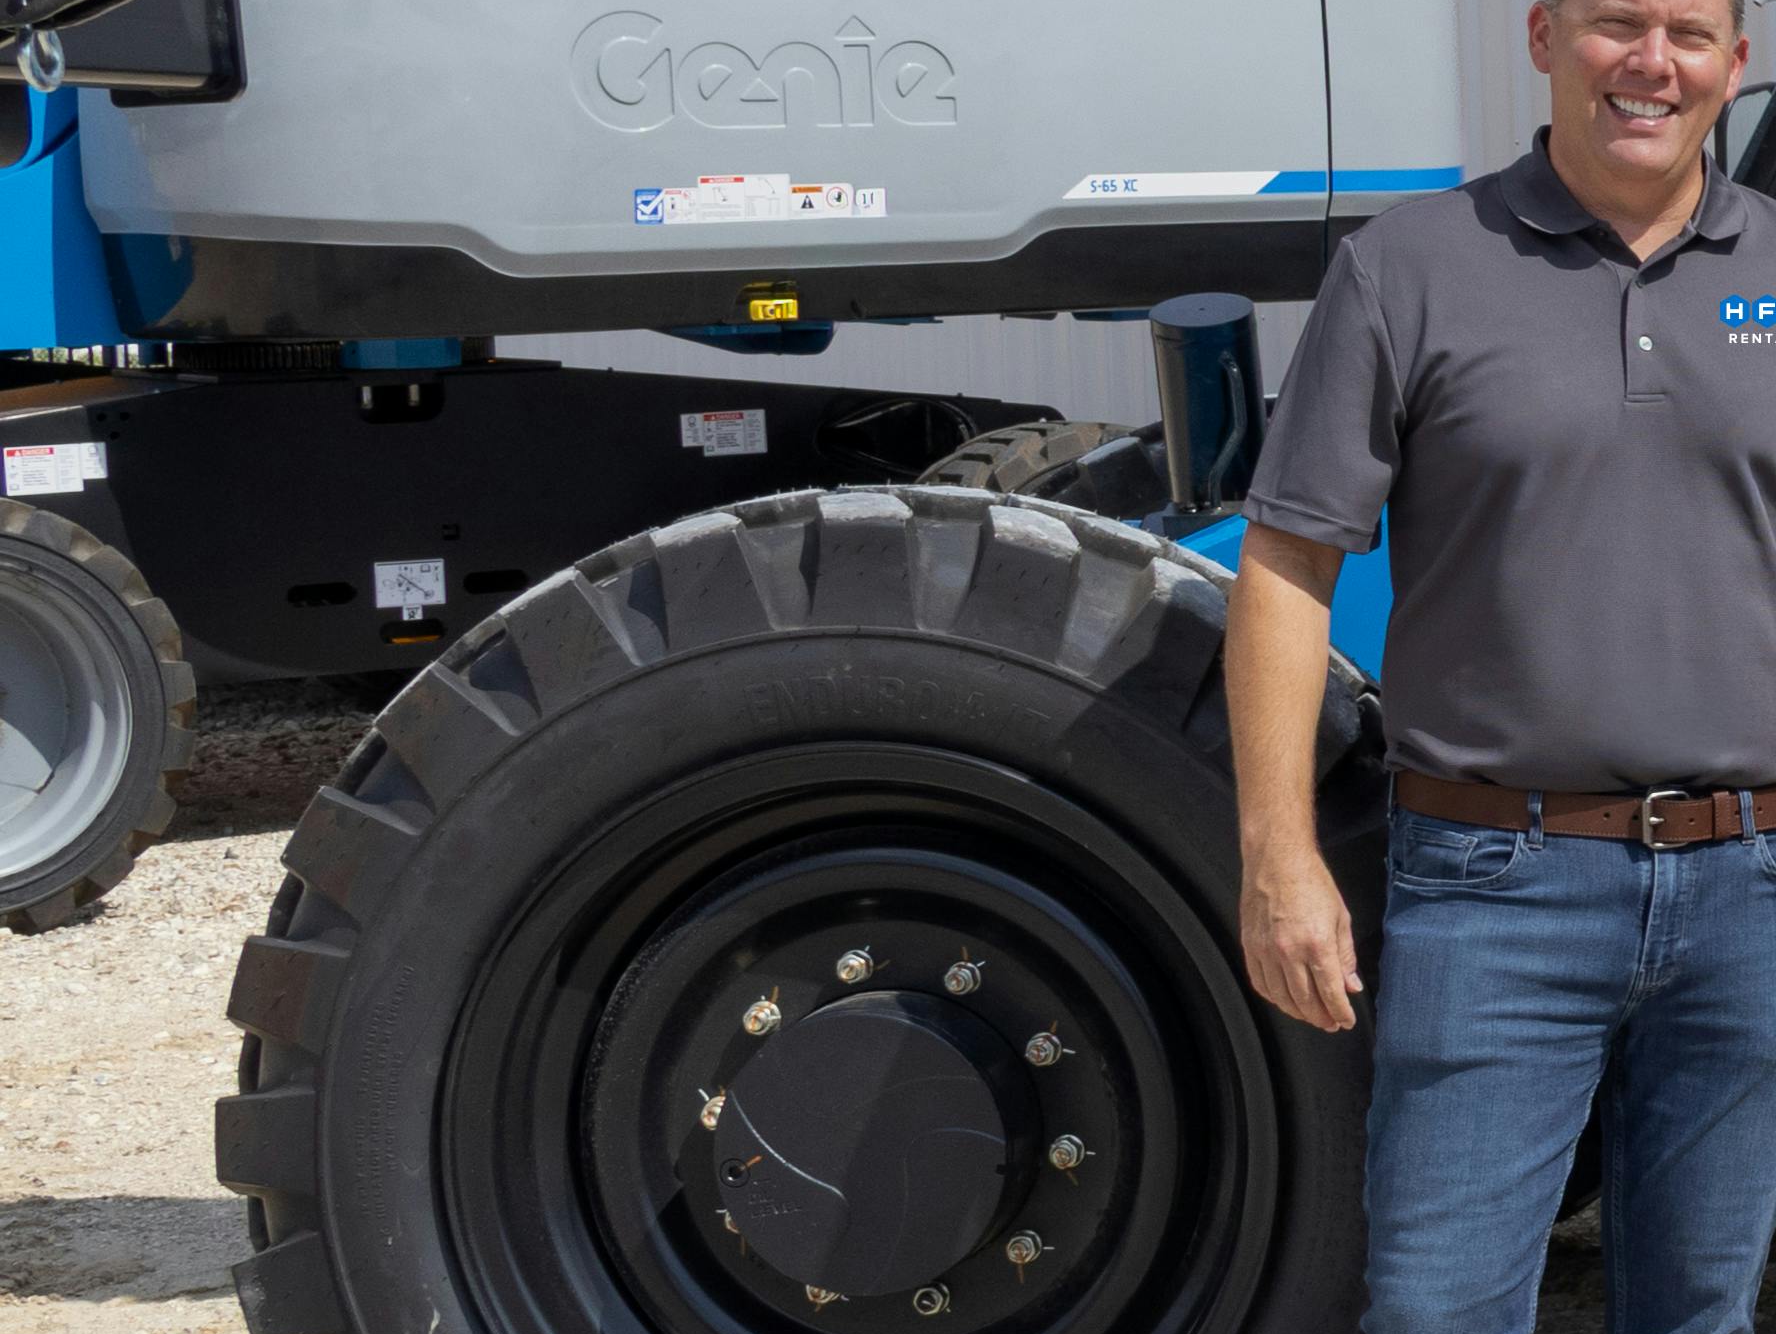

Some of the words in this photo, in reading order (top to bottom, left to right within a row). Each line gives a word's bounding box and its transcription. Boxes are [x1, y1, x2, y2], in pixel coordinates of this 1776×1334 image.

[569, 9, 959, 133] Genie
[1090, 179, 1118, 194] S-65
[1123, 178, 1138, 193] XC
